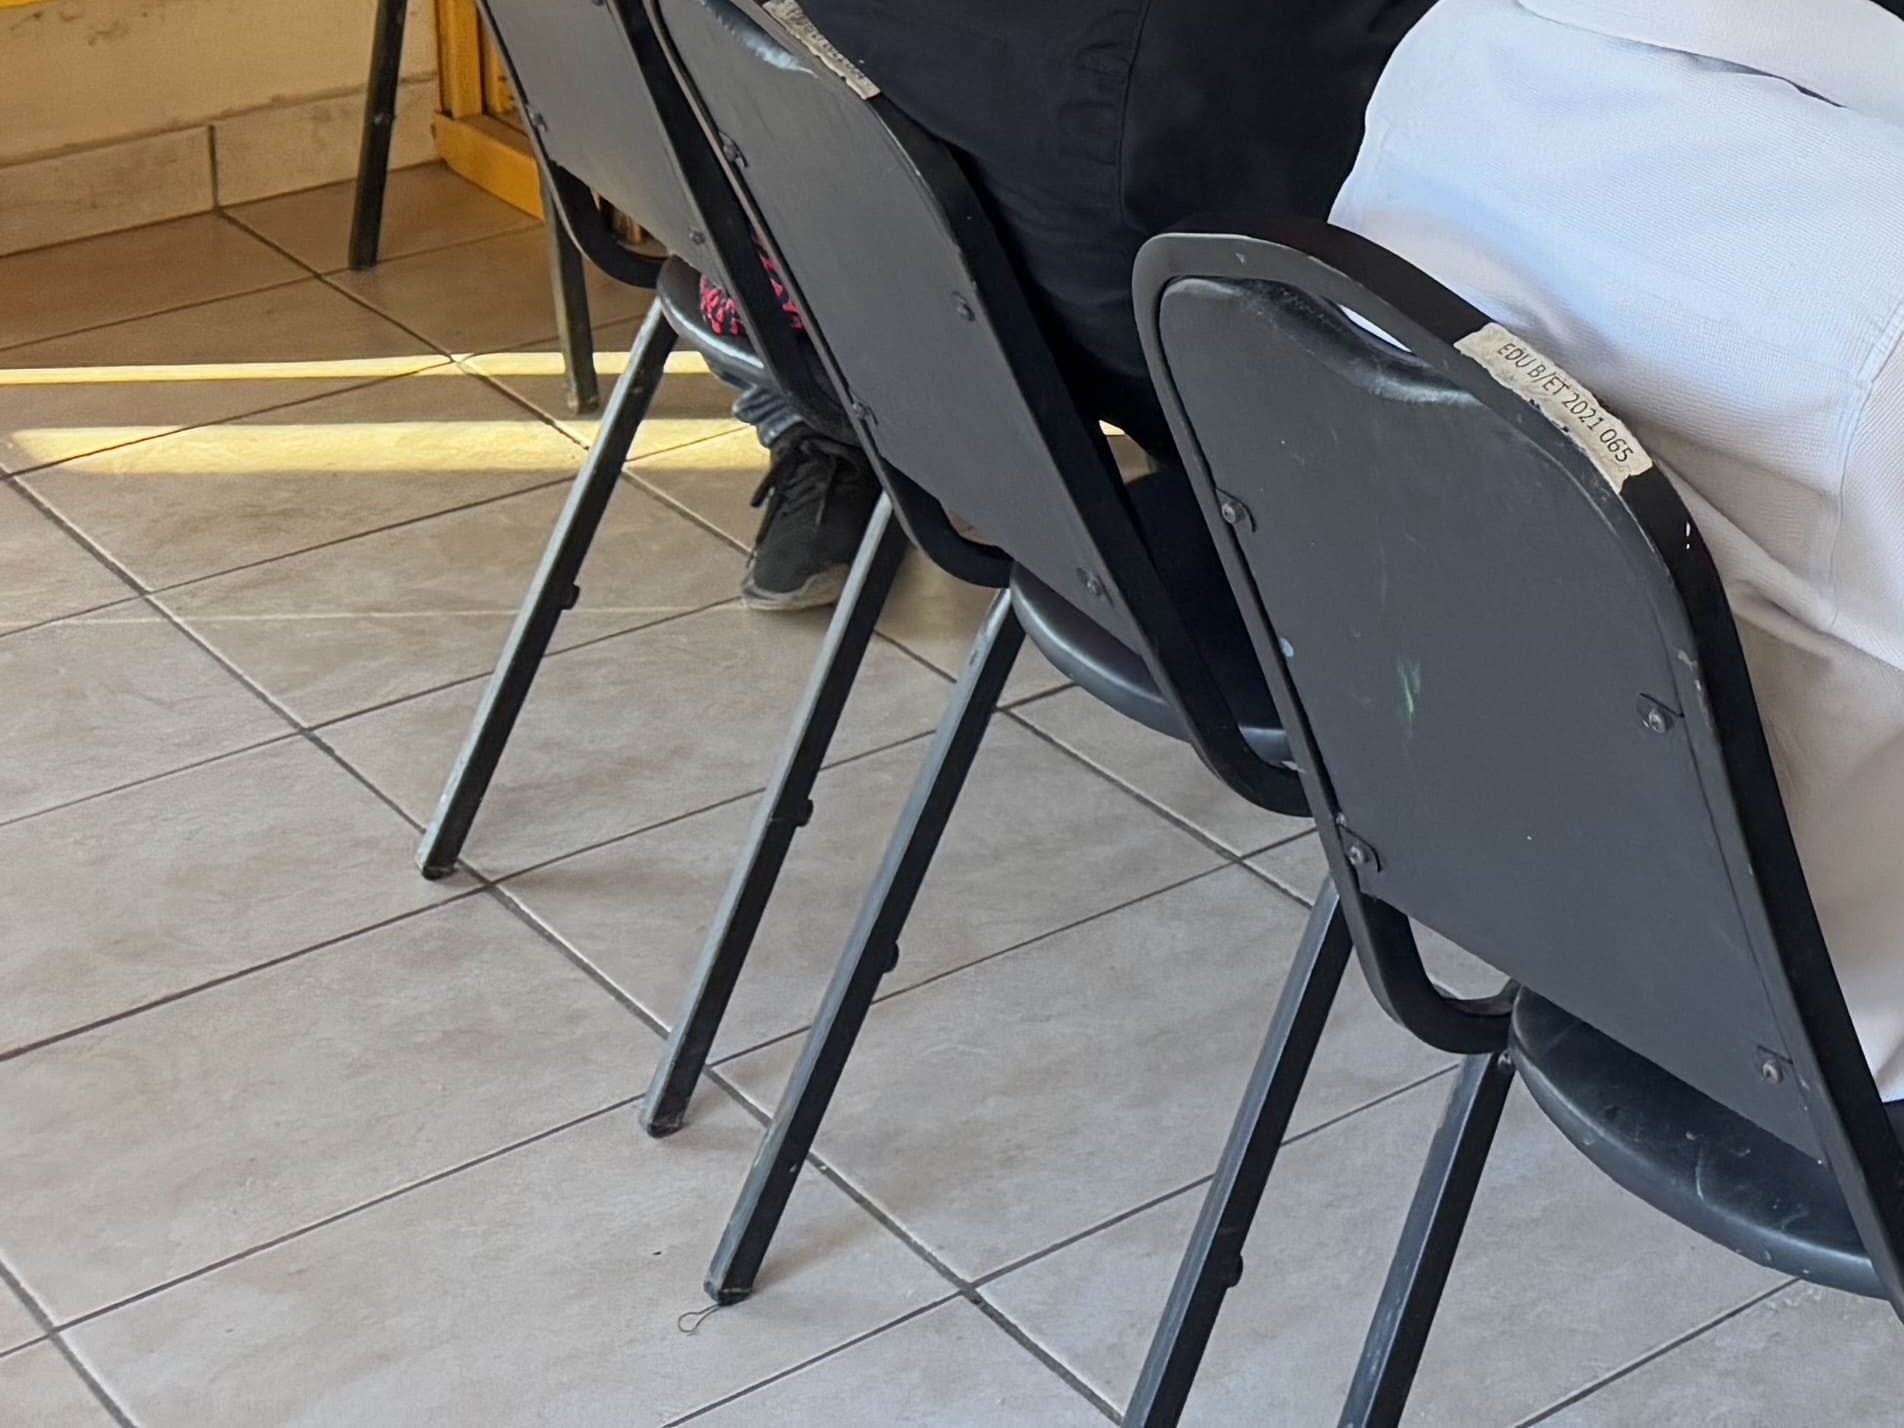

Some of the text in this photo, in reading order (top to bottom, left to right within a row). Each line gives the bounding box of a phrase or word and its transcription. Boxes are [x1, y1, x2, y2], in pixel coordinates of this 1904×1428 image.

[1496, 343, 1635, 464] EDU B/ET 2021 065
